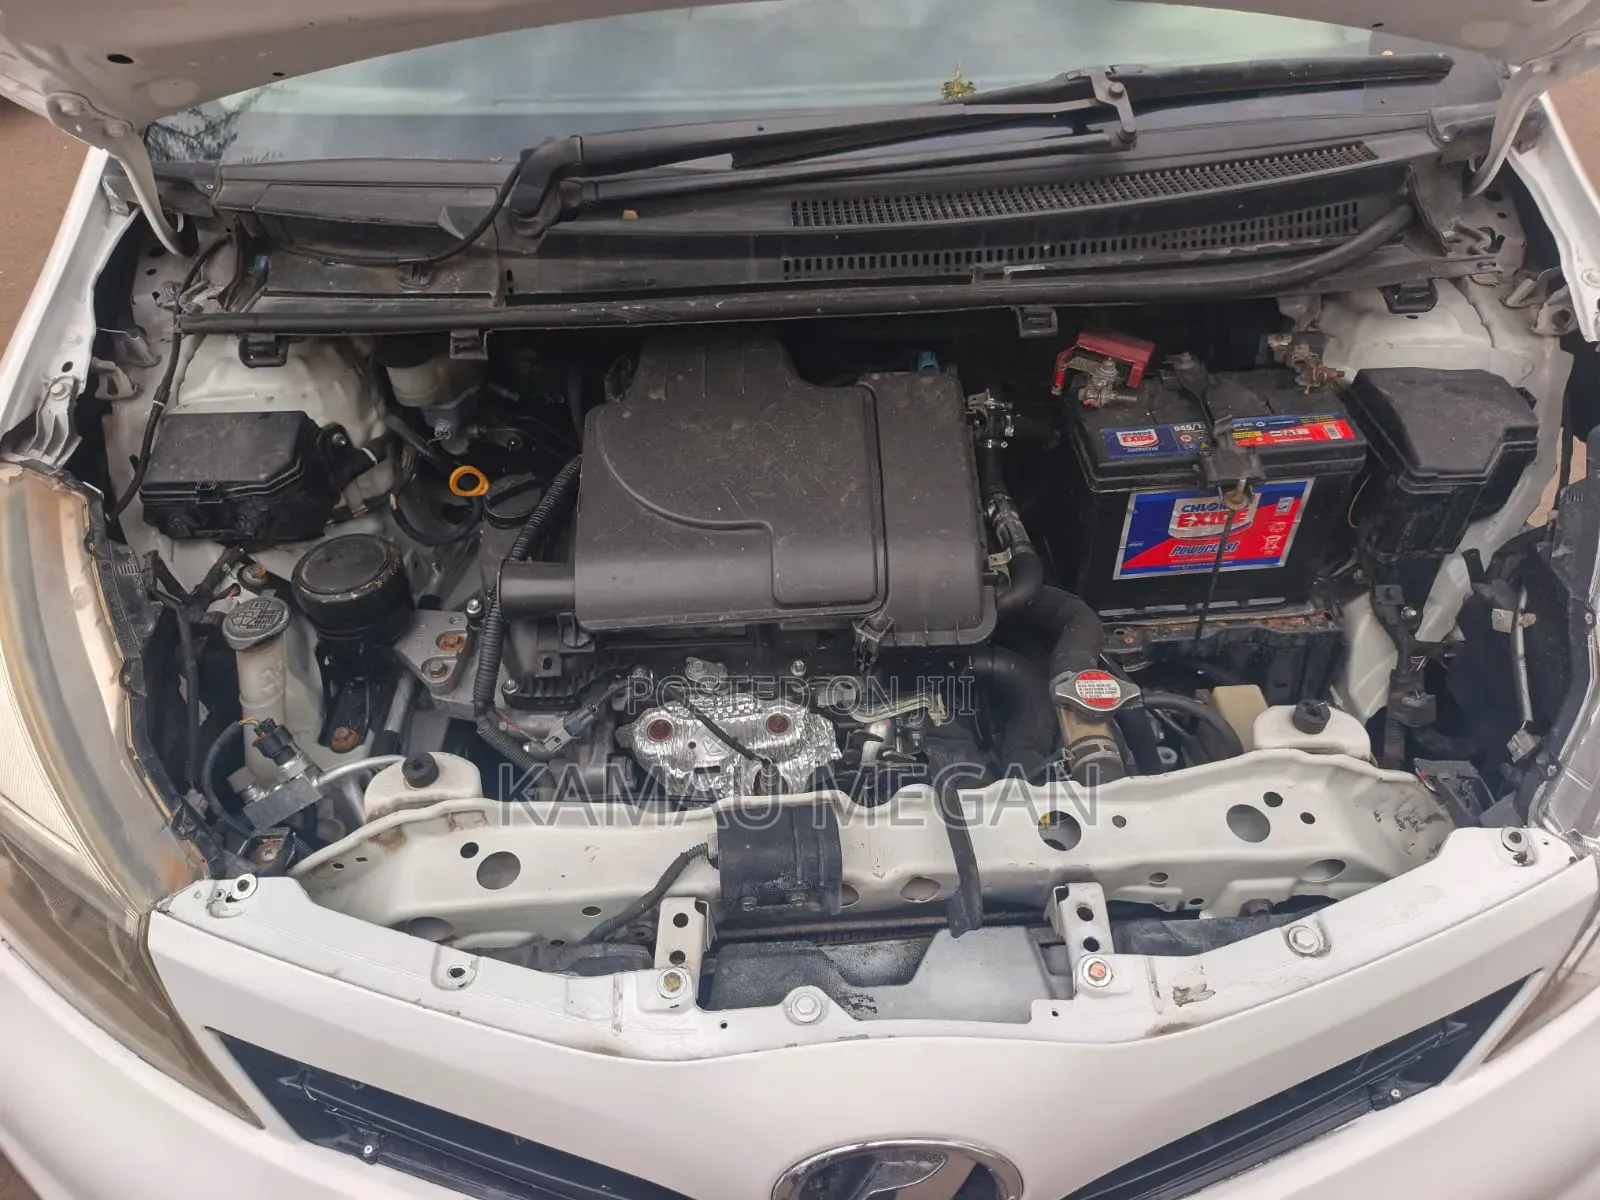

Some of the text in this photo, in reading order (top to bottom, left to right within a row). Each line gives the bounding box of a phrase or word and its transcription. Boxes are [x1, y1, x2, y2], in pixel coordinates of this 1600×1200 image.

[1122, 435, 1154, 443] EXIDE
[1181, 502, 1230, 513] CHLOR
[1177, 508, 1249, 528] EXIDE
[1169, 541, 1240, 557] PowerLst
